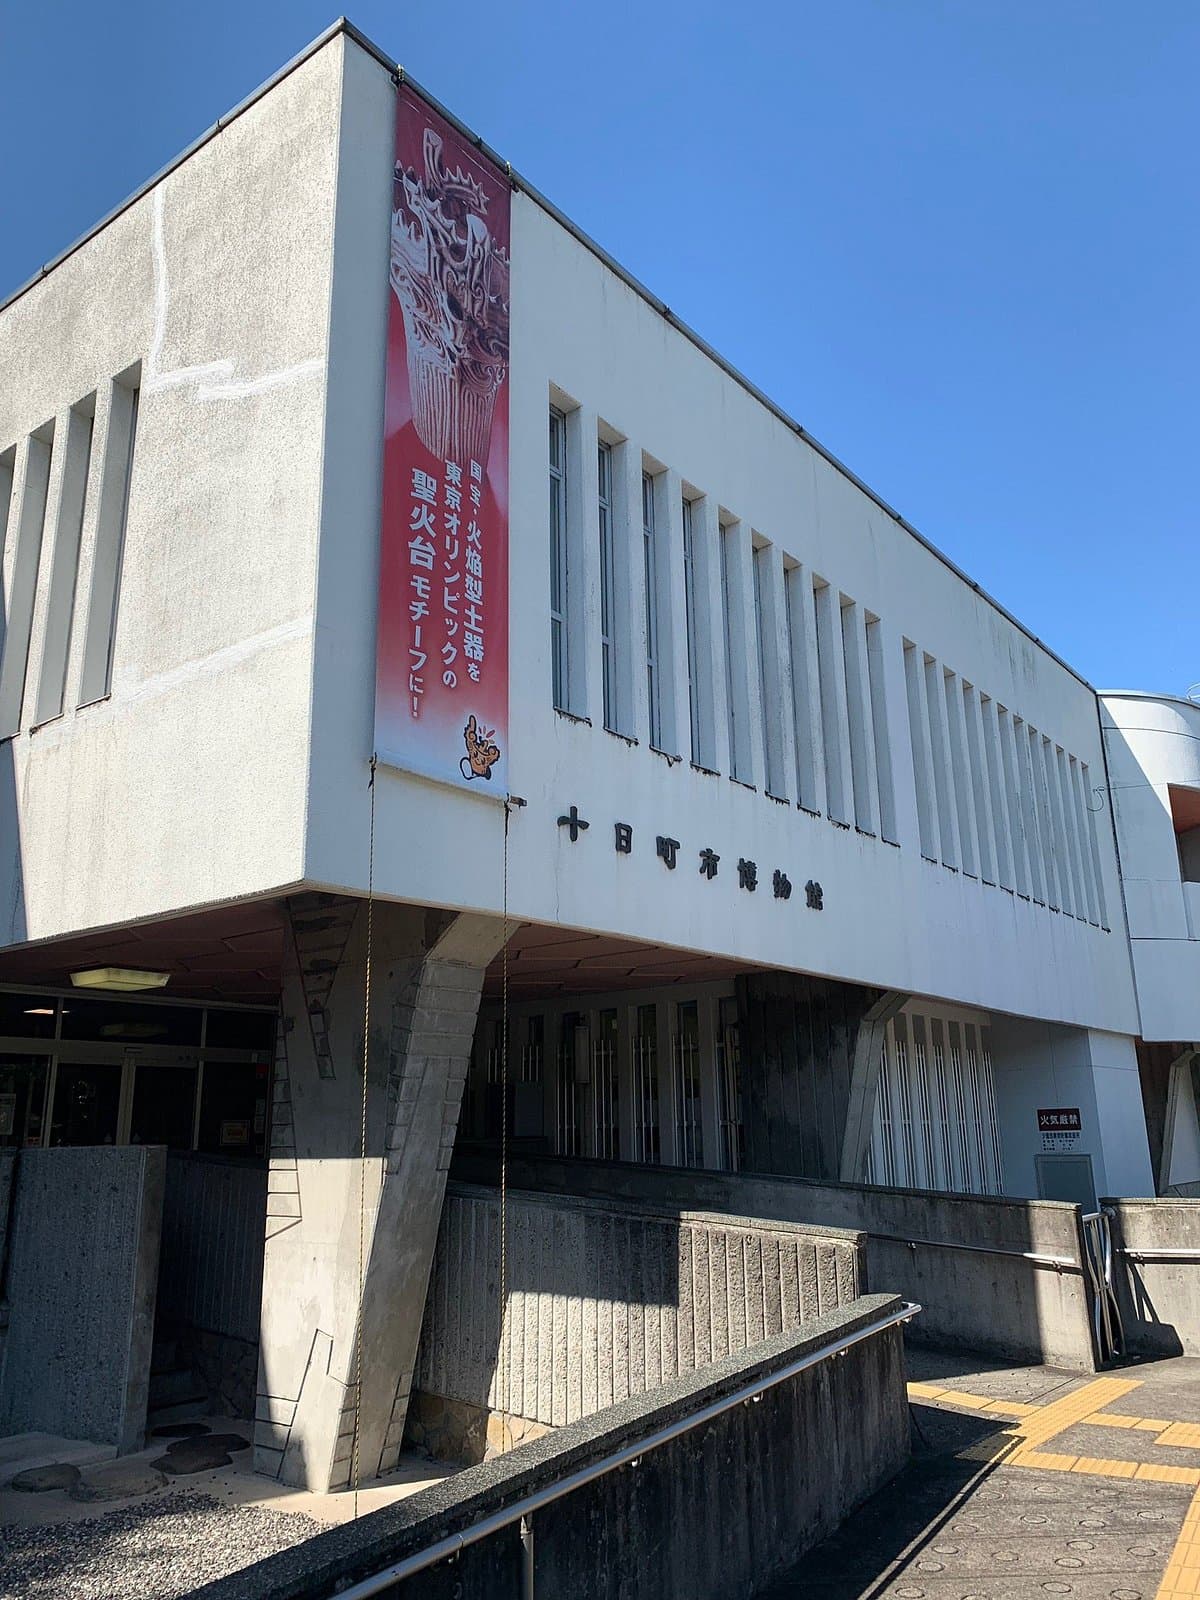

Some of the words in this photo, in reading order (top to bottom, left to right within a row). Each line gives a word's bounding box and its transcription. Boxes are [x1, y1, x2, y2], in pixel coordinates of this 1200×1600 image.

[441, 459, 462, 689] 東京オリンピックの
